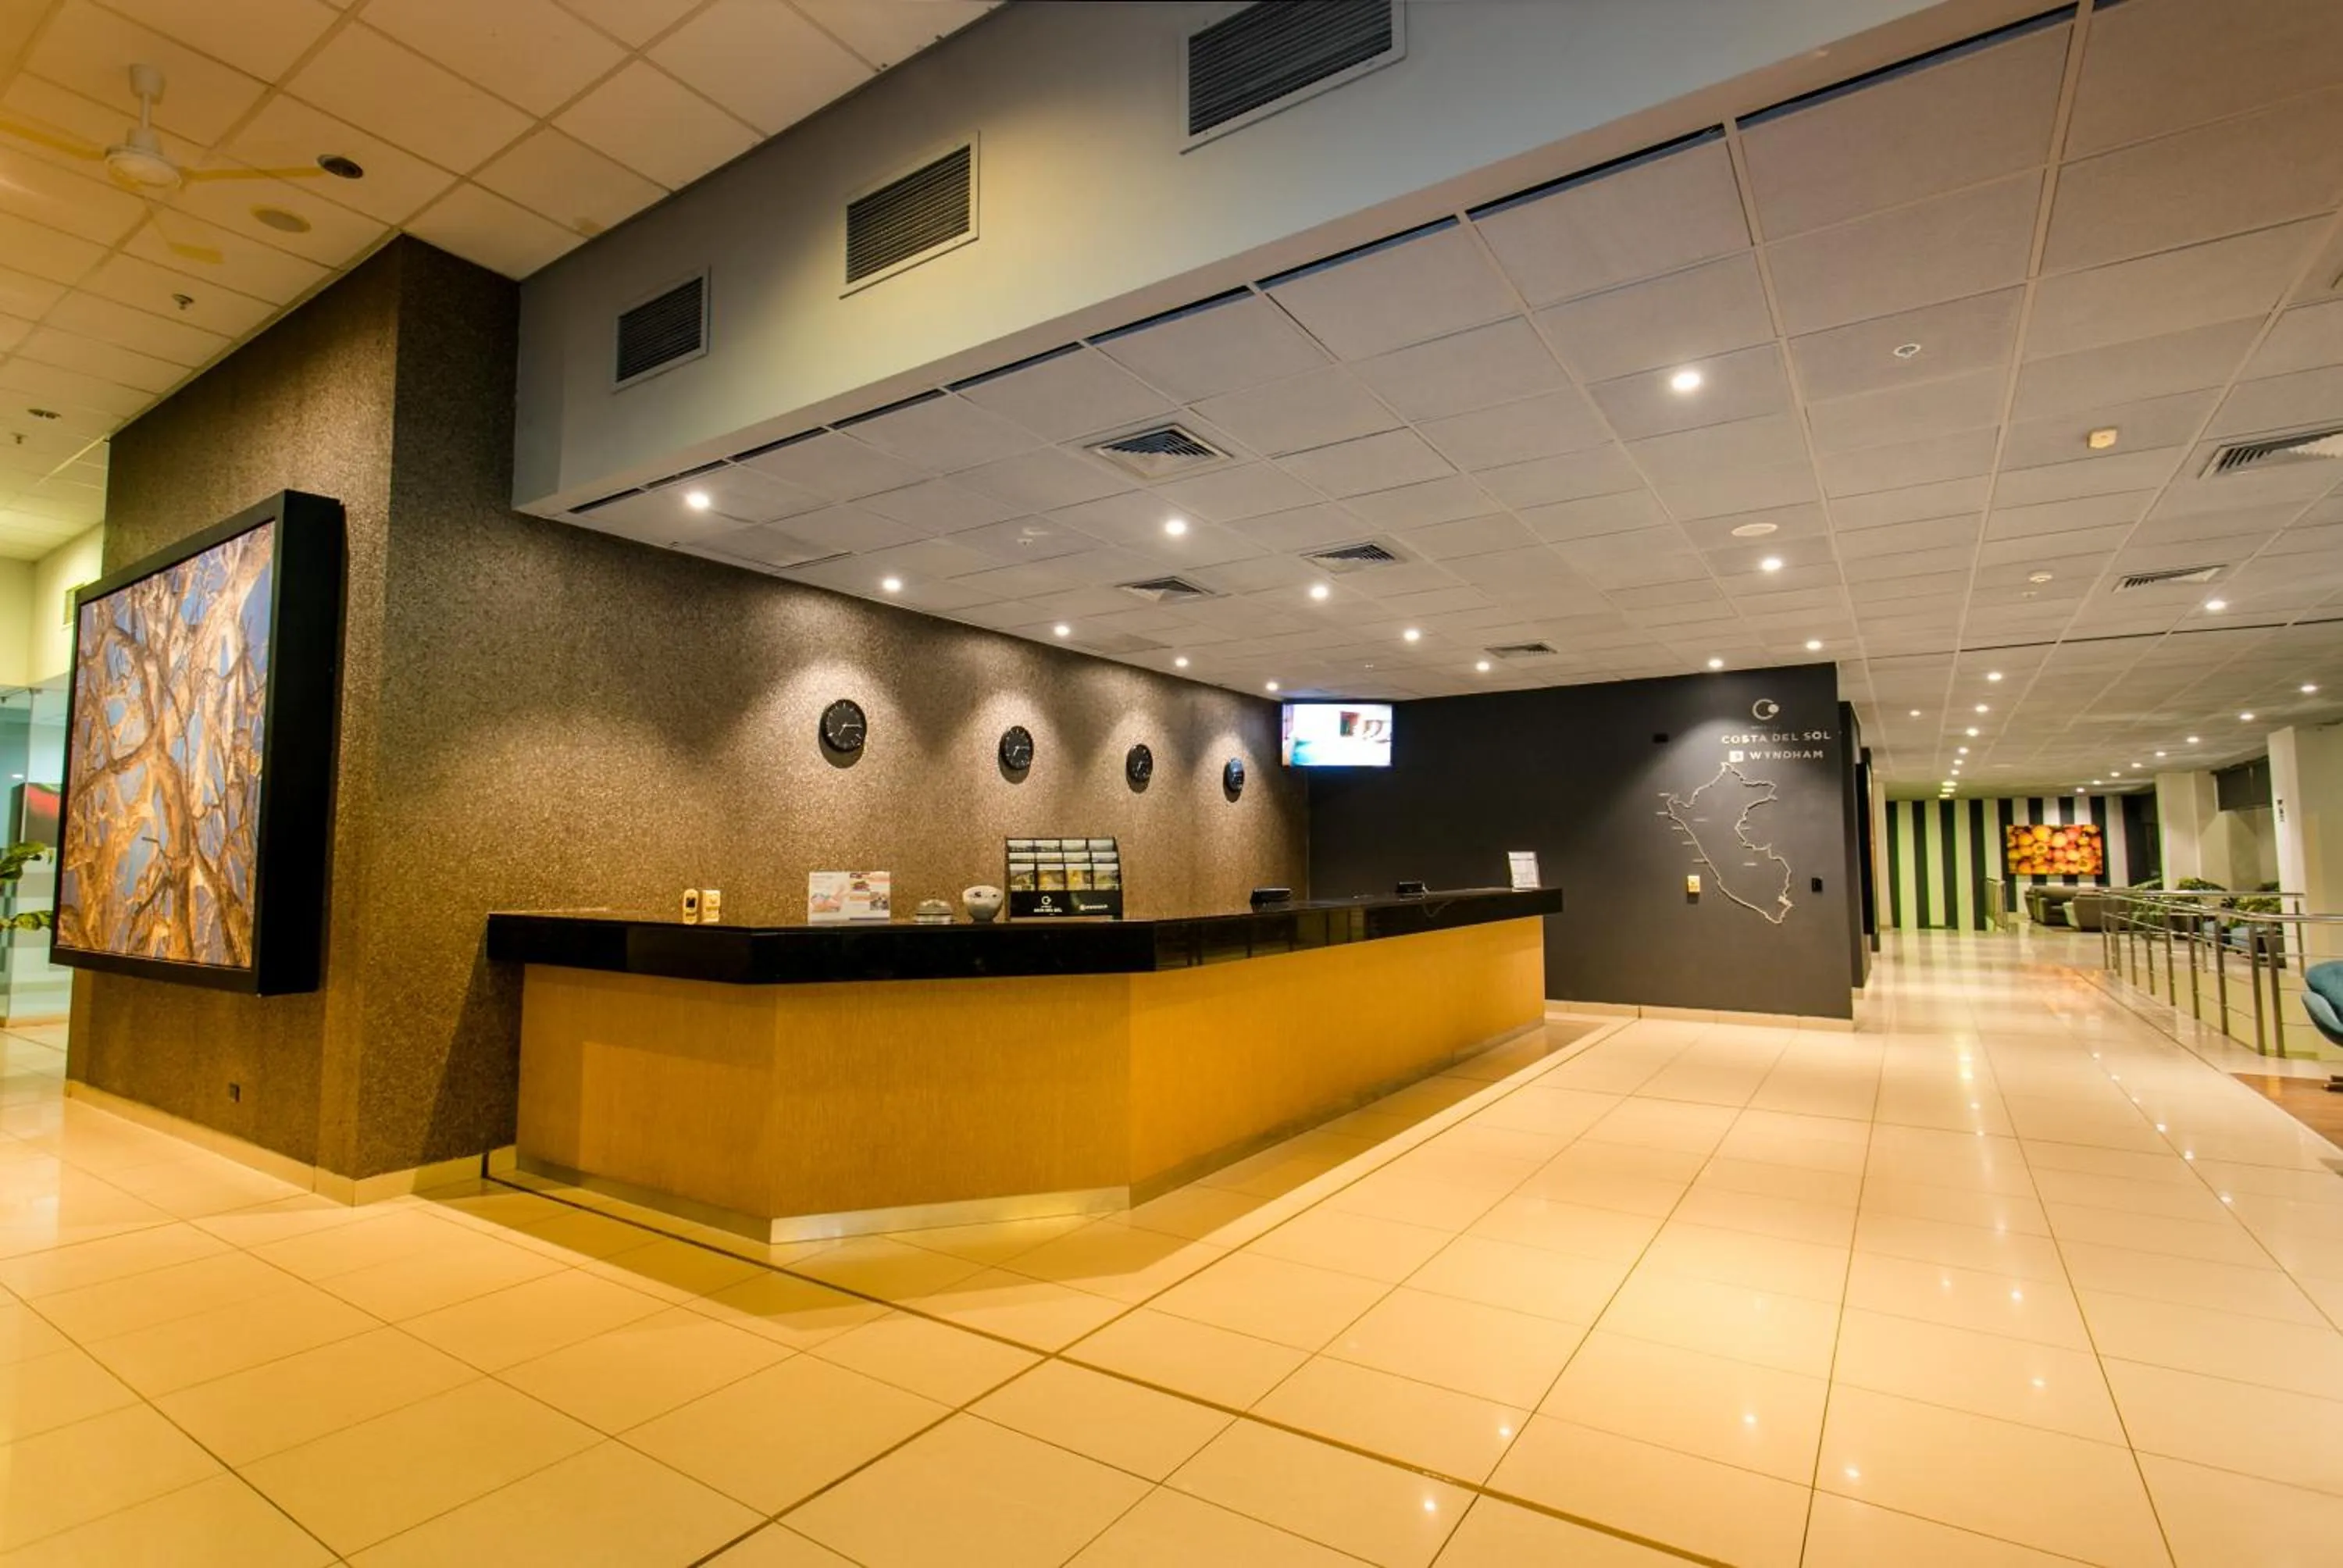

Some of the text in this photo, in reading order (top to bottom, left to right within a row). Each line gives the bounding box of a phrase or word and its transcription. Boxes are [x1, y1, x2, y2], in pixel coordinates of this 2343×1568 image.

[1721, 730, 1831, 744] COSTA DEL SOL
[1749, 750, 1824, 760] WYNDHAM
